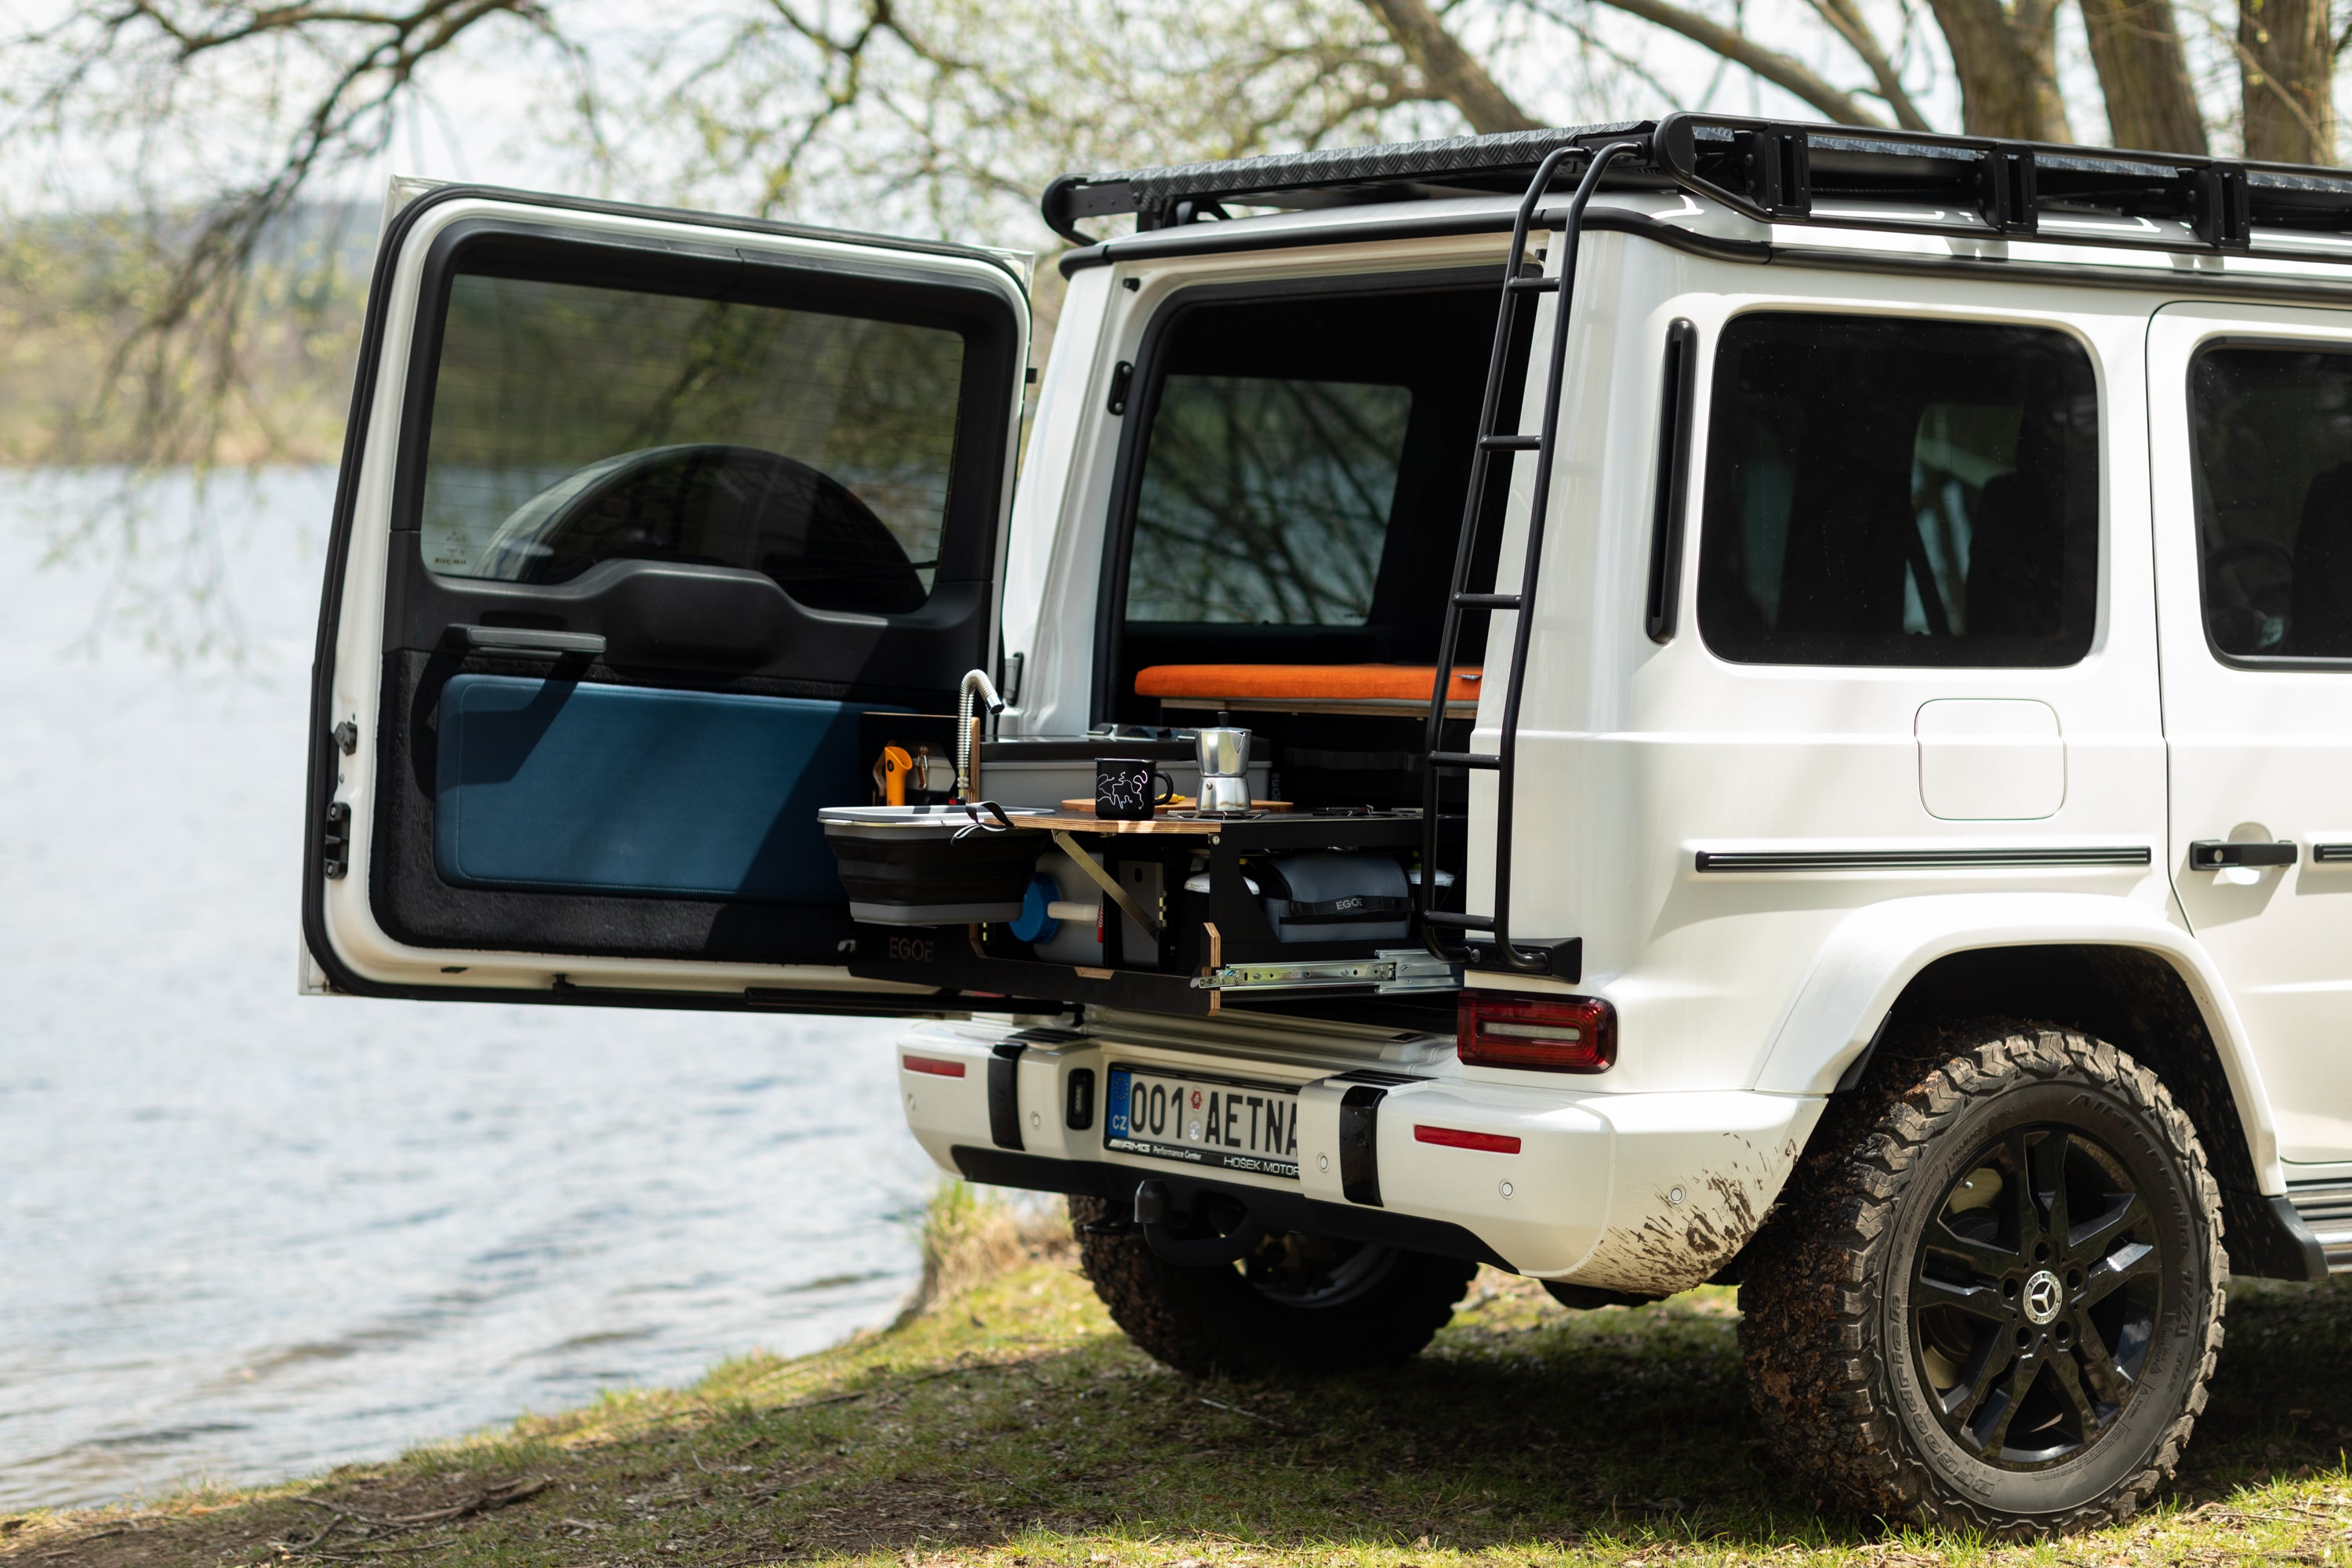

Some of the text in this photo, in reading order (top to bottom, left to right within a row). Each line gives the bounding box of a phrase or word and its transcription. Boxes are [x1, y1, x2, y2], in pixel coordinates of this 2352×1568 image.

[1336, 898, 1363, 910] EGOE
[889, 937, 935, 963] EGOE
[1112, 1115, 1127, 1131] CZ
[1131, 1081, 1298, 1156] 001 AETNA
[1122, 1142, 1202, 1160] AMG Performance Center
[1224, 1156, 1260, 1171] HOŠEK
[1889, 1294, 1996, 1498] BFGoodrich
